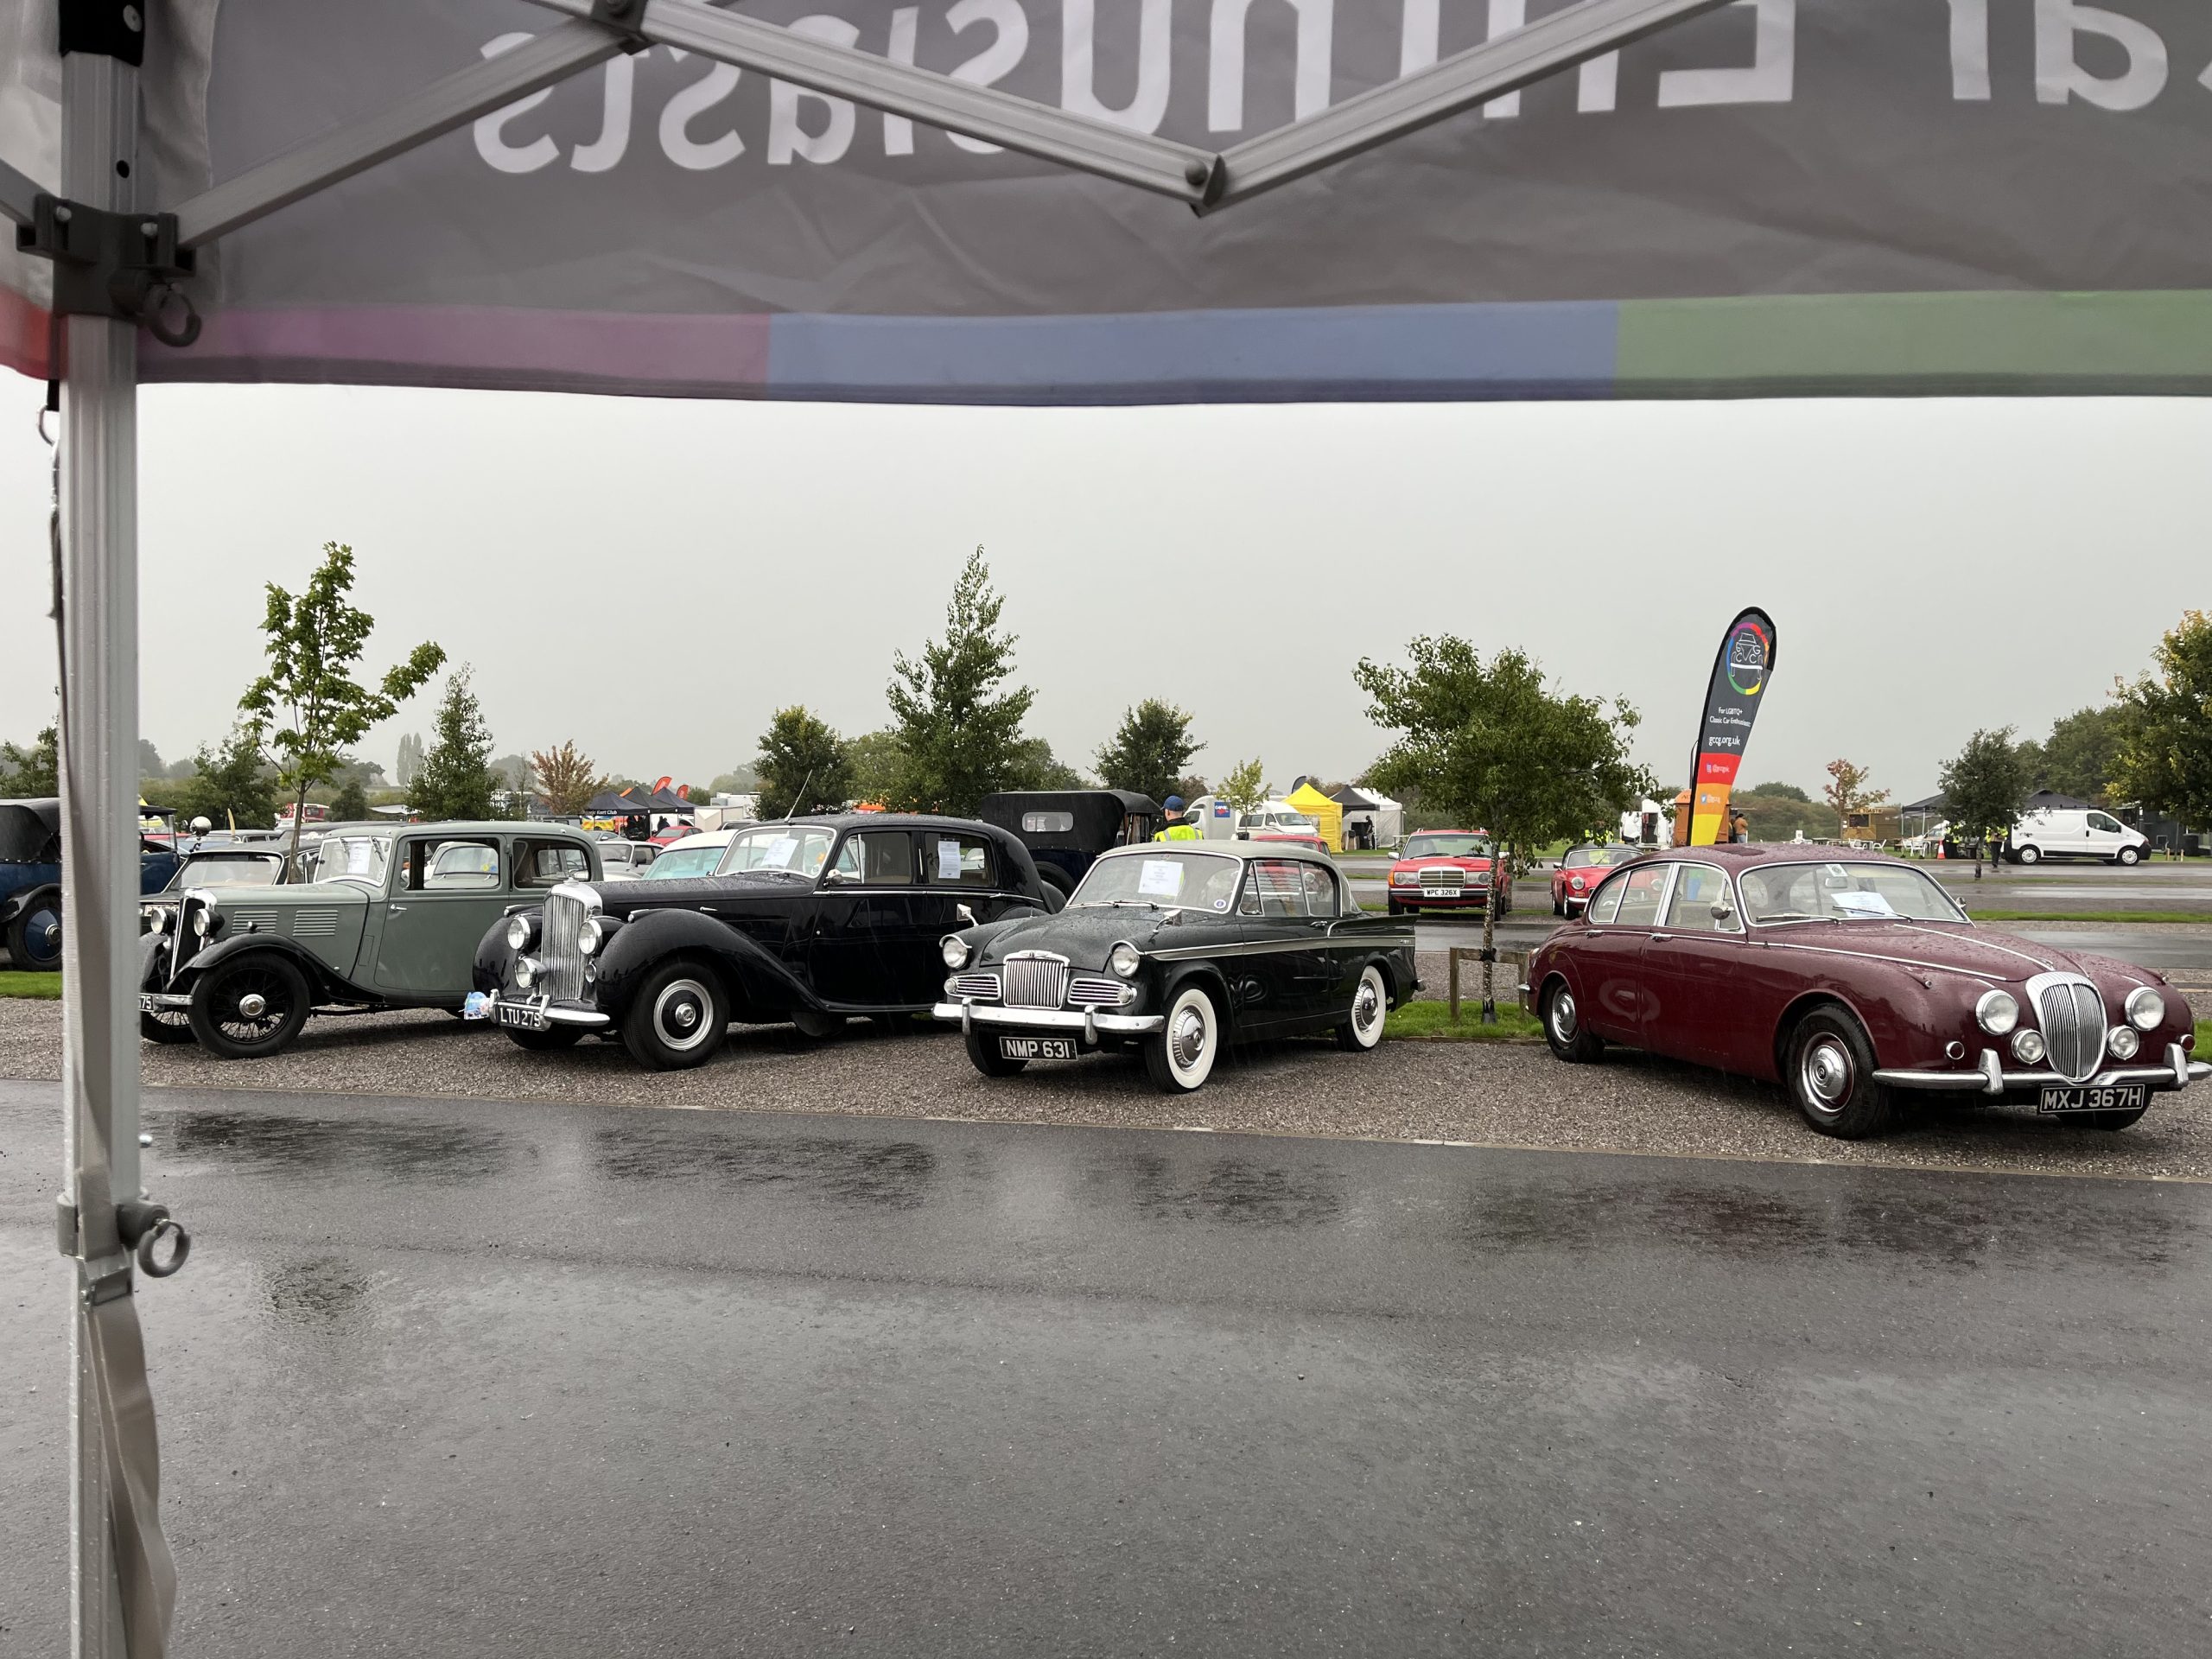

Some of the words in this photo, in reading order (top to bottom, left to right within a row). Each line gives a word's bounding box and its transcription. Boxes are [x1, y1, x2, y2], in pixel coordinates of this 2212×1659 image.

[1709, 735, 1740, 747] gccg.org.uk
[500, 1007, 519, 1024] LTU
[1006, 1039, 1038, 1057] NMP
[1042, 1040, 1070, 1058] 631
[2044, 1090, 2084, 1109] MXJ
[2088, 1087, 2141, 1108] 367H
